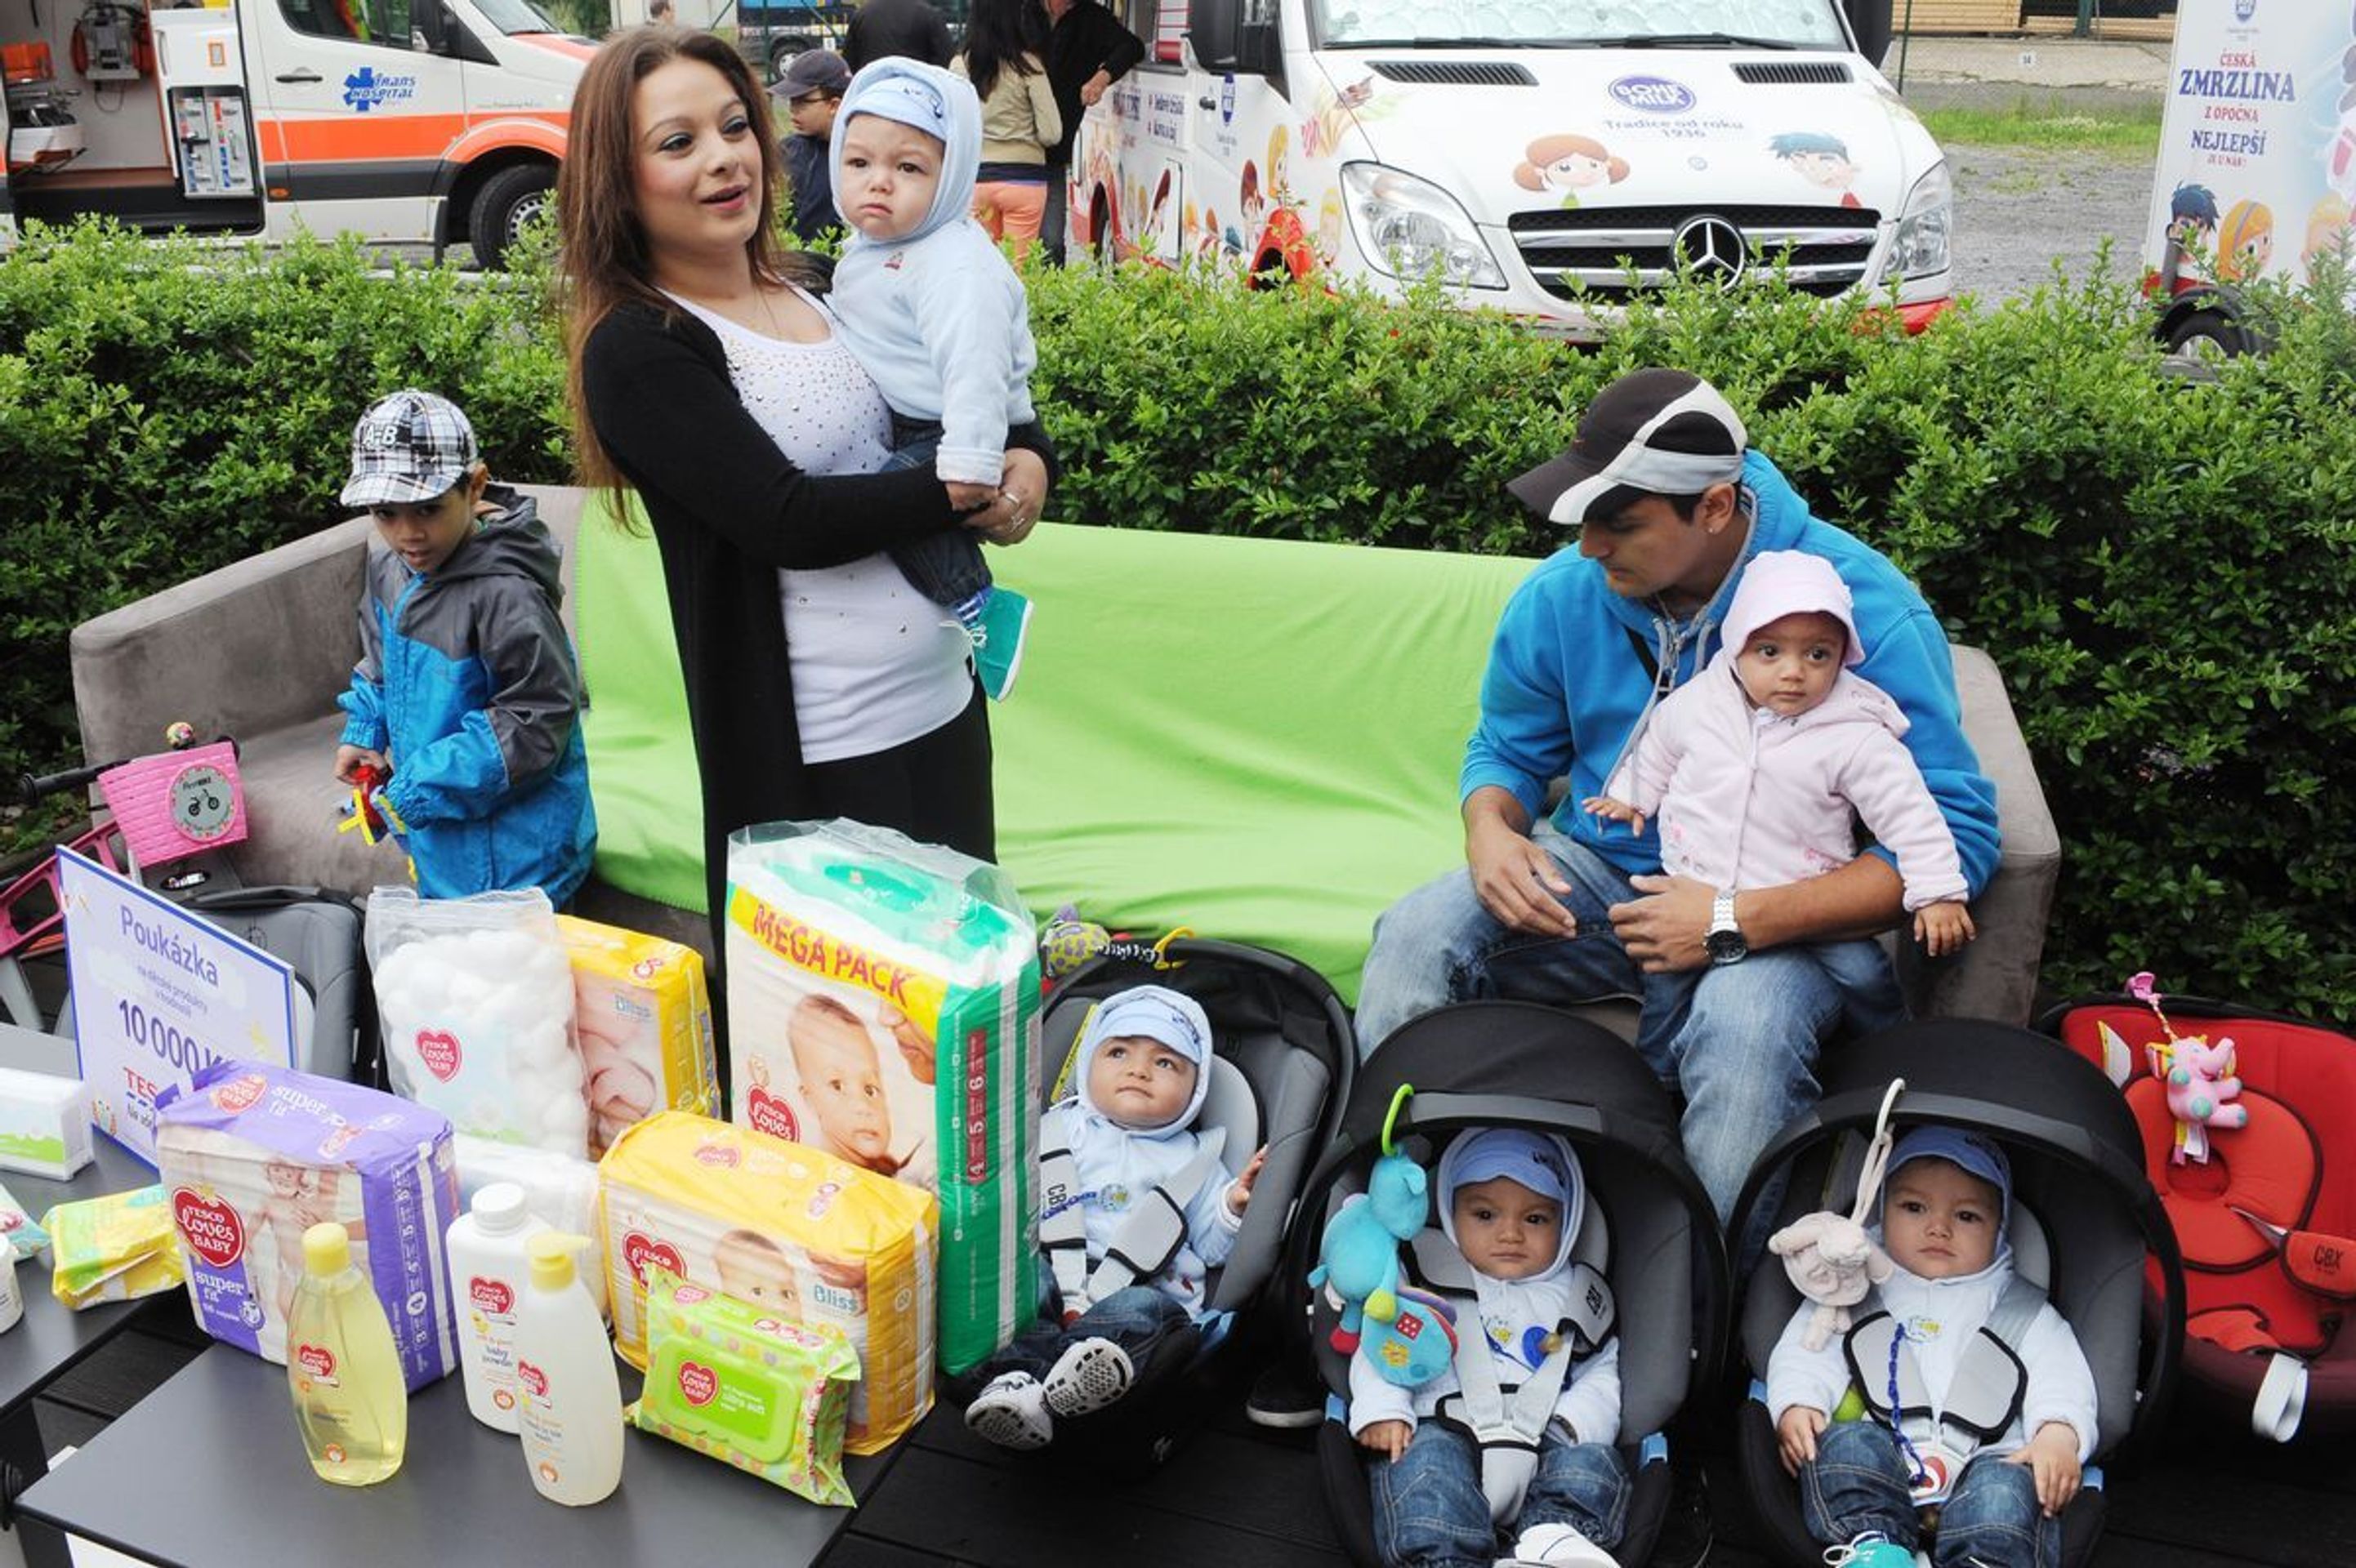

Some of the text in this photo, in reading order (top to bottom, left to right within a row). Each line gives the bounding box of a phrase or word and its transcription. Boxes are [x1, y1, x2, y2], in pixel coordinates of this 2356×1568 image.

[2179, 69, 2296, 101] ZMRZLINA
[2191, 128, 2266, 155] NEJLEPŠÍ
[120, 904, 219, 988] Poukázka
[753, 903, 917, 1009] MEGA PACK
[119, 999, 146, 1045] 10
[150, 1017, 199, 1076] 000
[969, 1076, 985, 1091] 6
[969, 1119, 985, 1135] 5
[969, 1160, 985, 1176] 4
[187, 1205, 225, 1223] TESCO
[192, 1232, 231, 1254] BABY
[194, 1271, 245, 1296] super
[814, 1283, 856, 1312] Bliss
